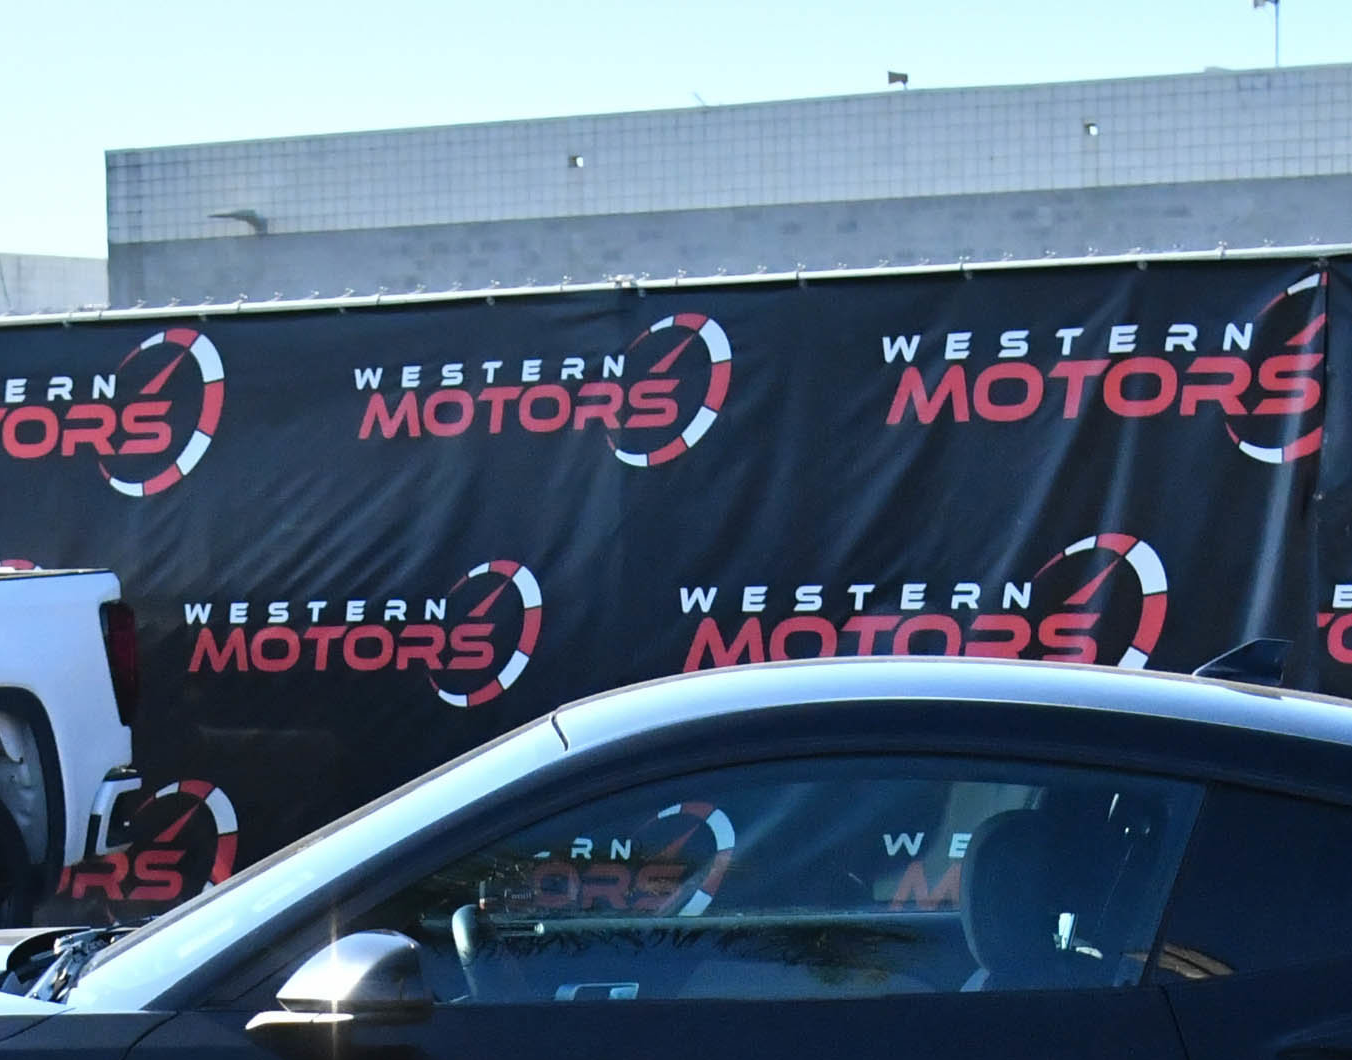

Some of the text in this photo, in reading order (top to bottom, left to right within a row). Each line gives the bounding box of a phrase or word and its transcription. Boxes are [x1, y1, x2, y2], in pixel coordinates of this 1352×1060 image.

[882, 322, 1253, 363] WESTERN
[354, 354, 625, 390] WESTERN
[885, 352, 1324, 425] MOTORS
[358, 378, 680, 440] MOTORS
[184, 598, 446, 625] WESTERN
[679, 582, 1032, 613] WESTERN
[188, 623, 496, 674] MOTORS
[683, 613, 1101, 673] MOTORS
